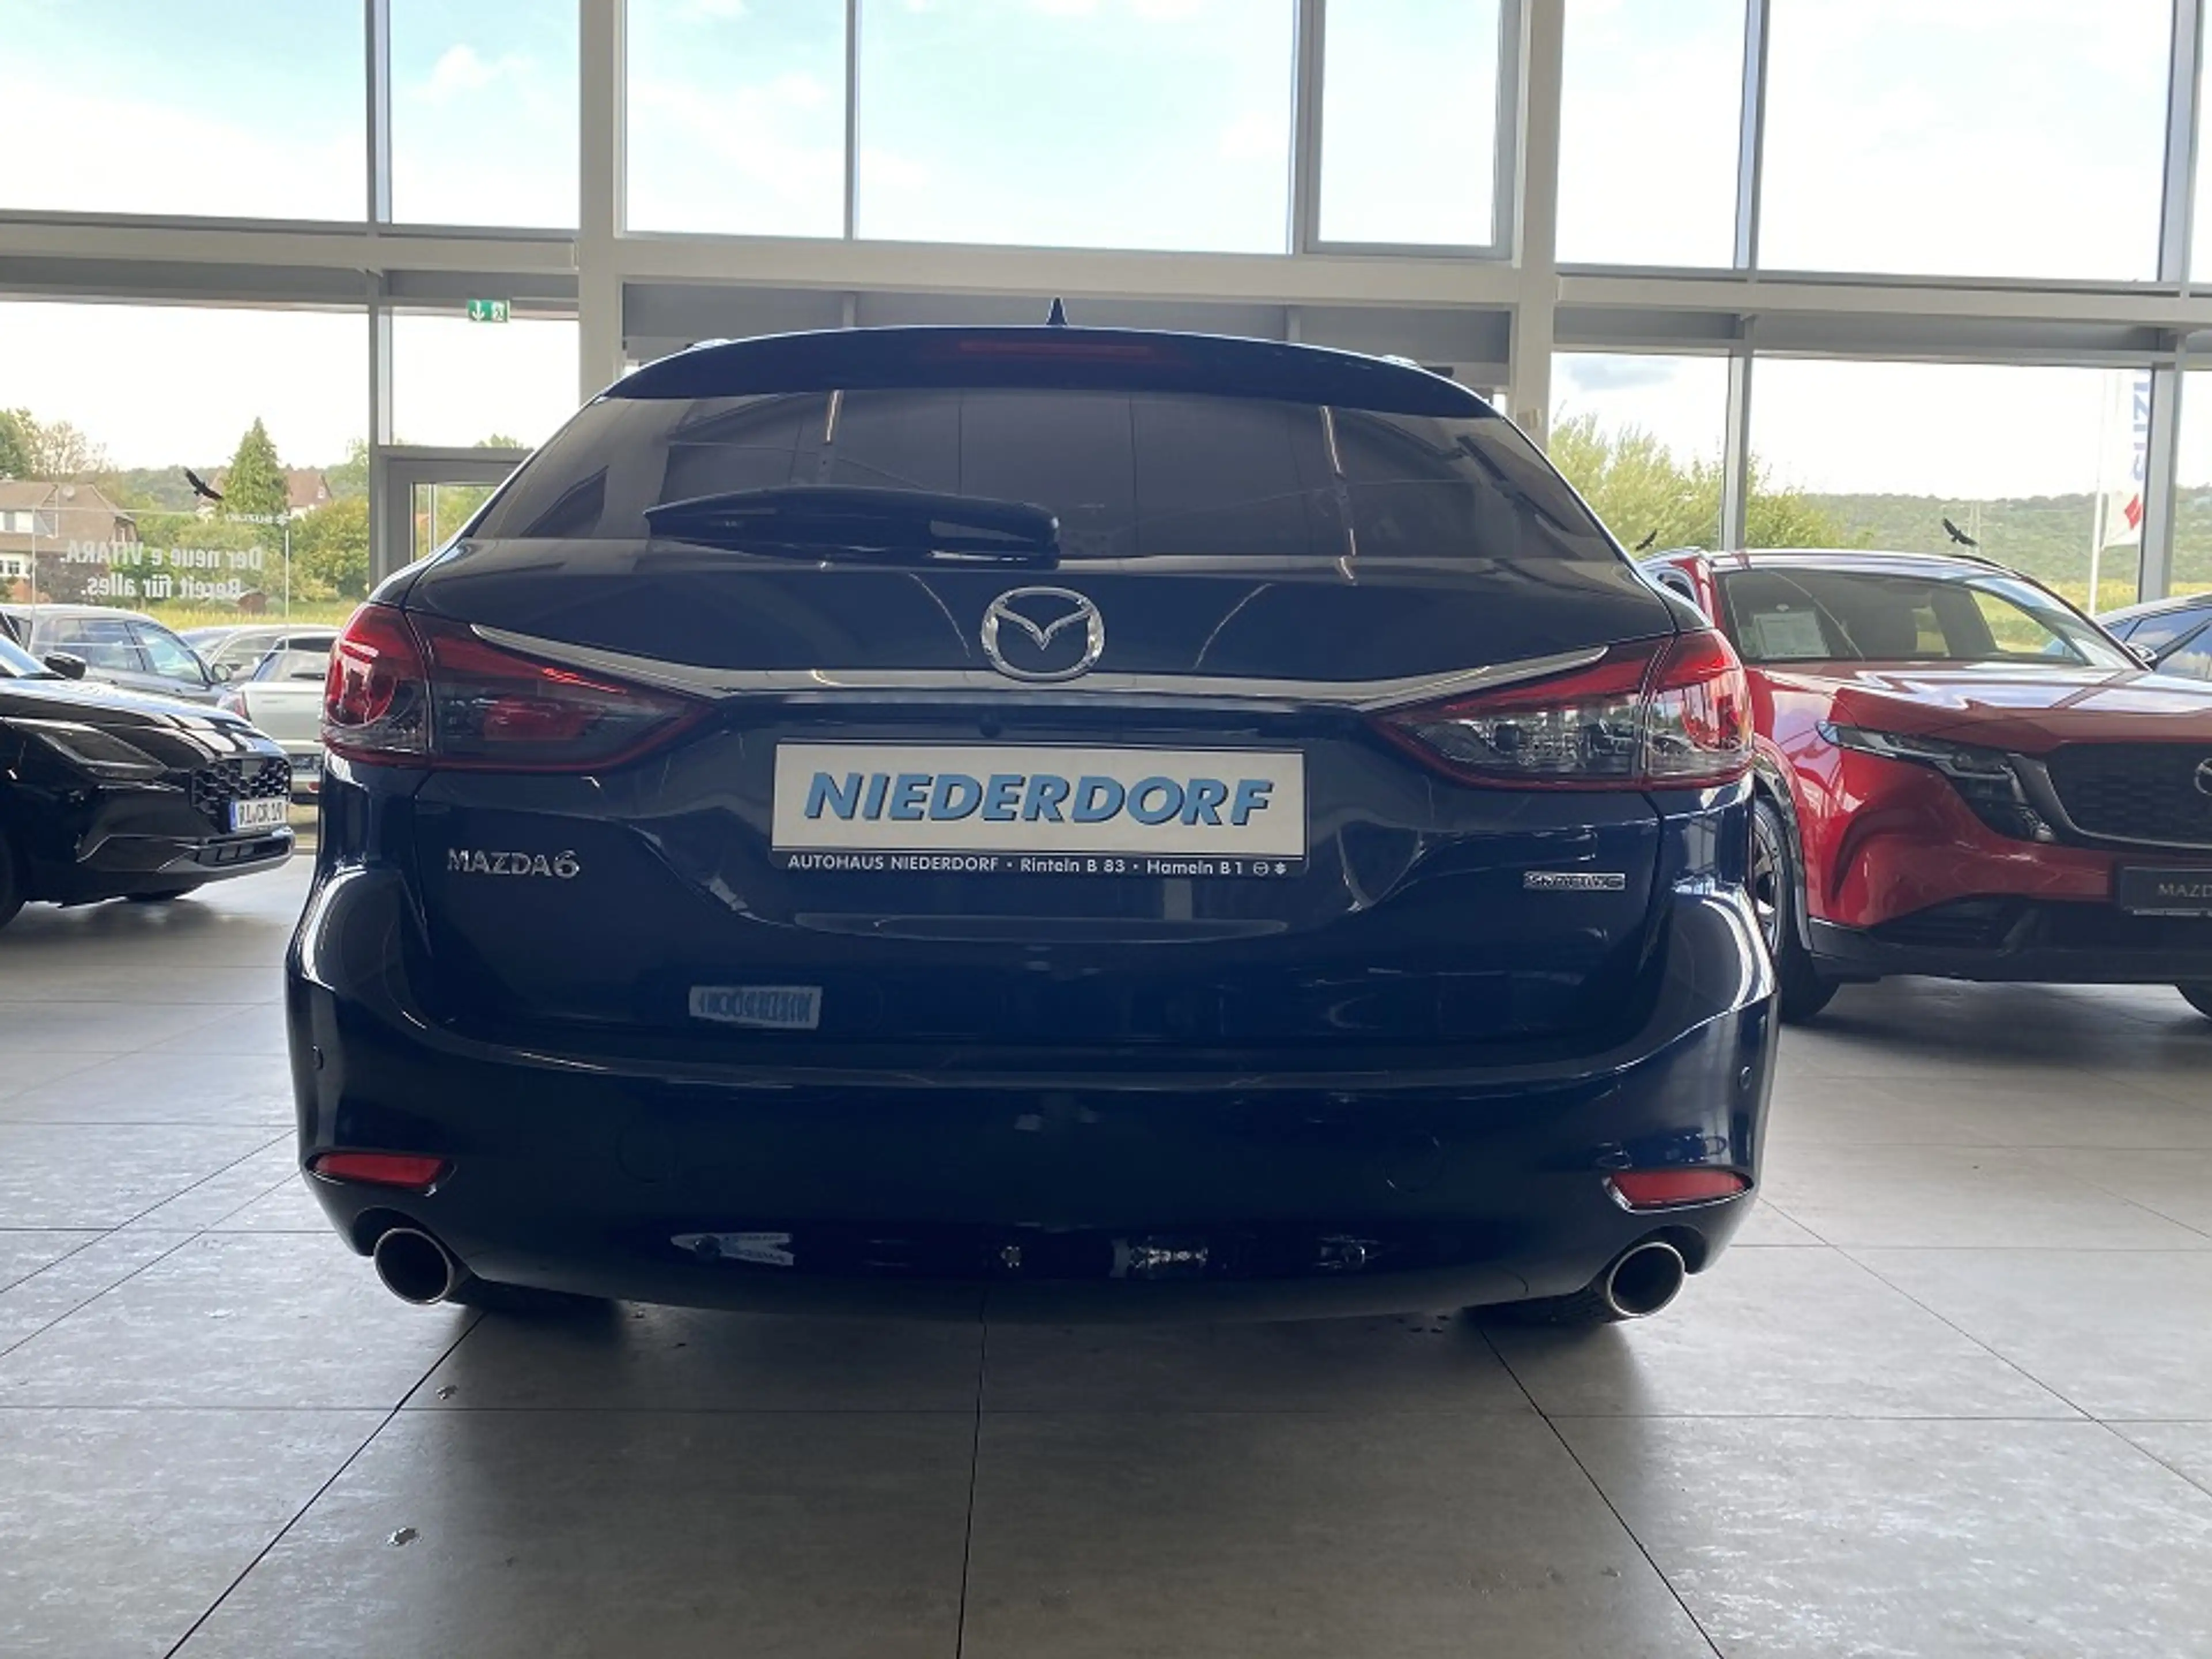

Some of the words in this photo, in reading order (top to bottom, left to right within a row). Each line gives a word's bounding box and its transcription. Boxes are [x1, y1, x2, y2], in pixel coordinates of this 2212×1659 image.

[804, 772, 1274, 825] NIEDERDORF
[448, 848, 579, 879] MAZDA6
[787, 854, 884, 870] AUTOHAUS
[891, 855, 999, 872] NIEDERDORF
[1020, 857, 1080, 873] Rinteln
[1086, 859, 1097, 873] B
[1147, 859, 1214, 874] Hameln
